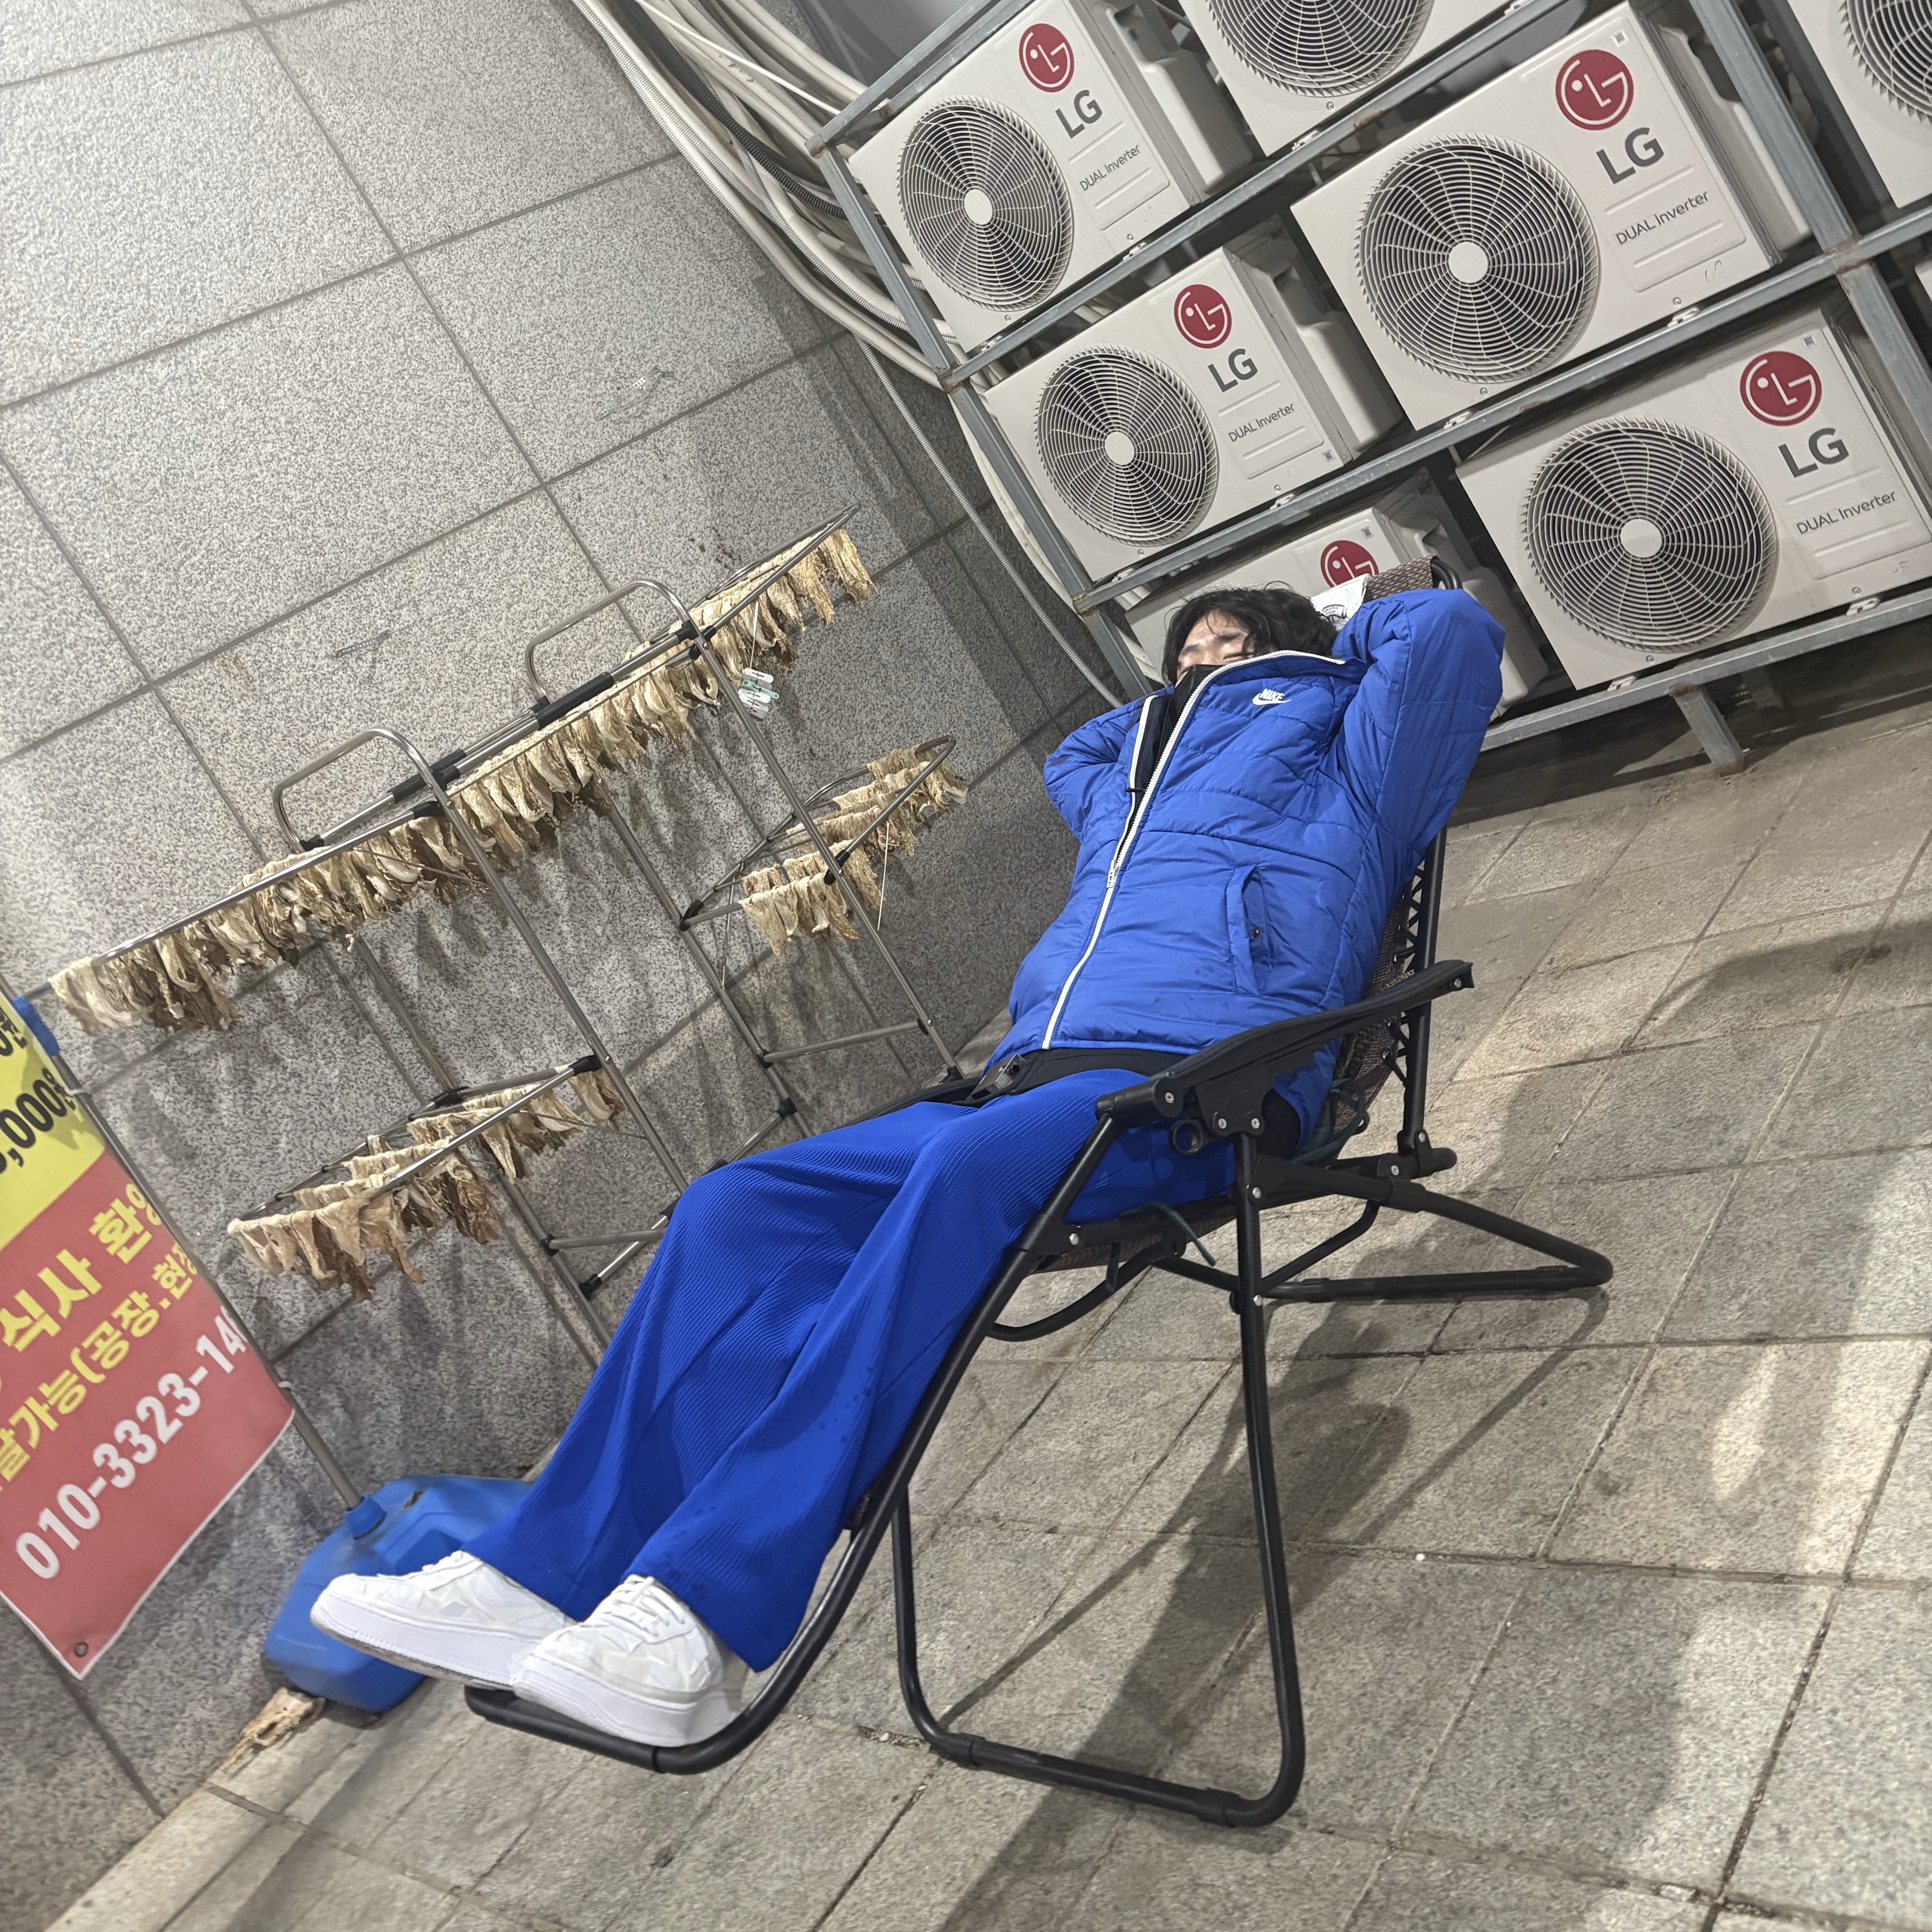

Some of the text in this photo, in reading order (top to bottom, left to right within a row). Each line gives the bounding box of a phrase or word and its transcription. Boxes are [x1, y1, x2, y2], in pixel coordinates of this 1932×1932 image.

[1056, 90, 1102, 138] LG
[1079, 145, 1140, 191] DUAL Inverter
[1596, 128, 1664, 184] LG
[1615, 191, 1708, 245] DUAL Inverter
[1208, 349, 1258, 392] LG
[1228, 403, 1295, 442] DUAL Inverter
[1778, 428, 1849, 478] LG
[1796, 491, 1895, 534] DUAL Inverter
[1259, 688, 1285, 701] NIKE
[0, 1248, 102, 1352] 식사
